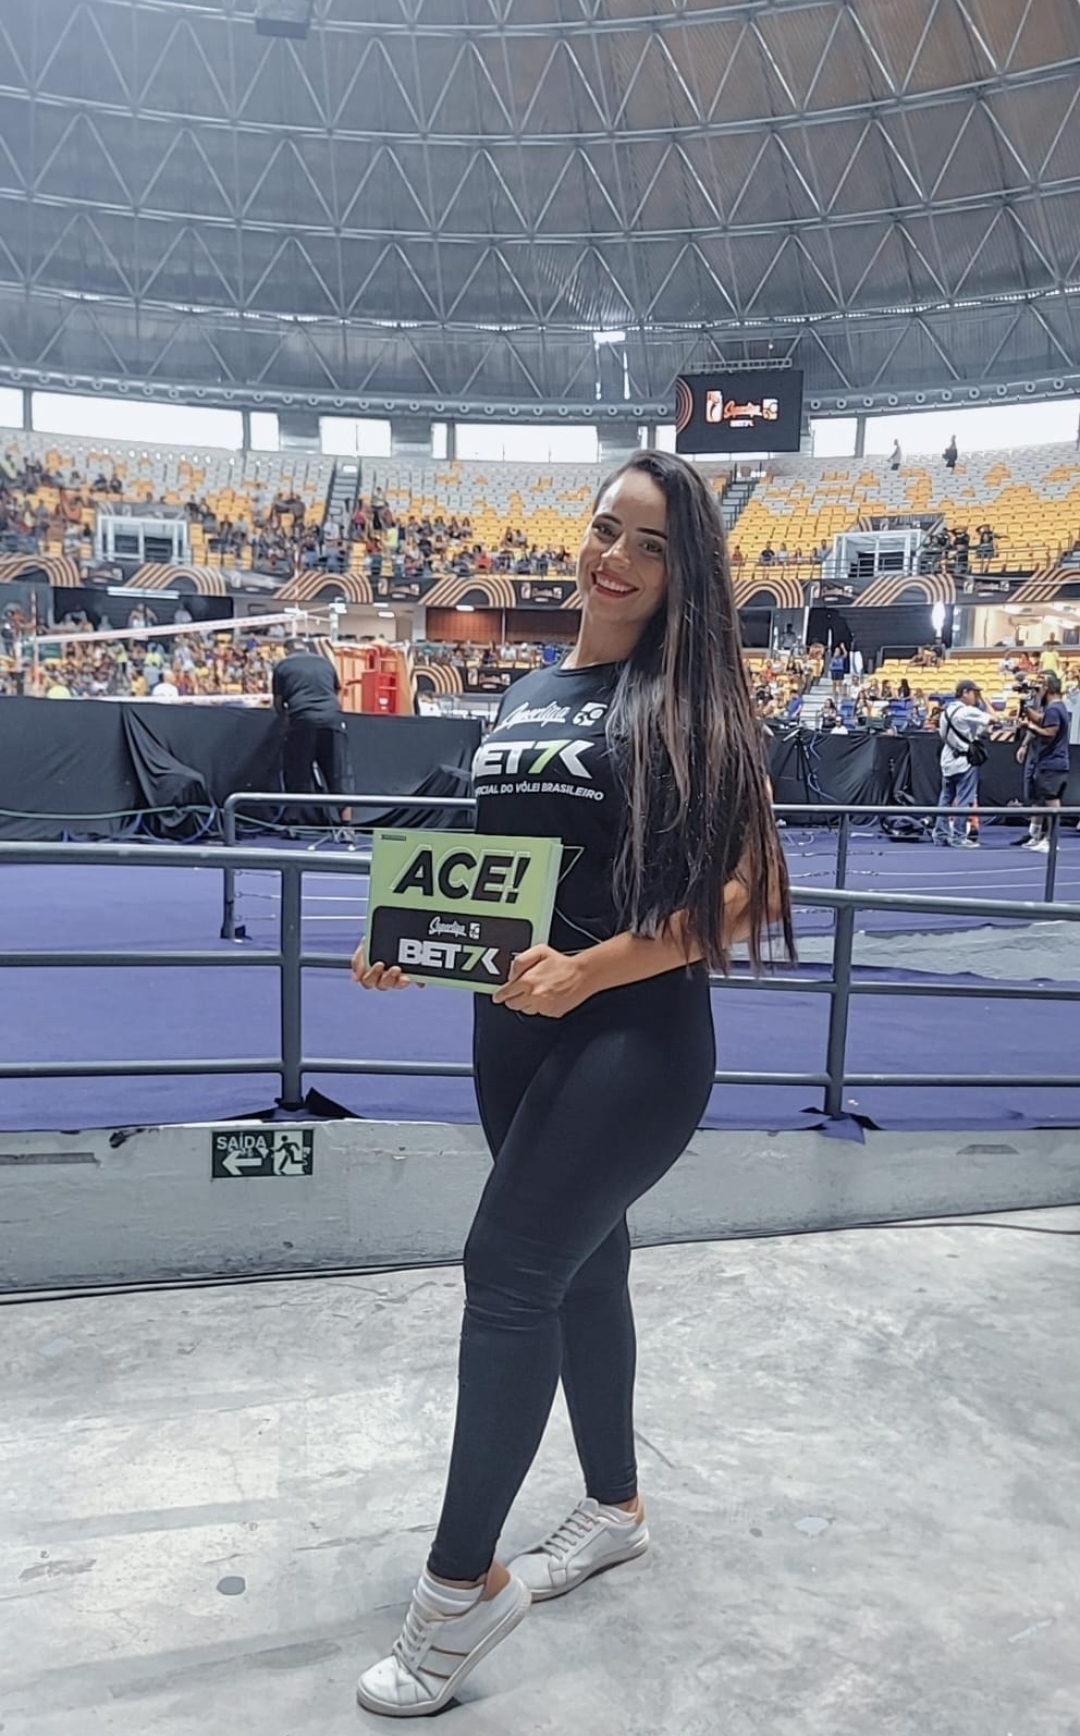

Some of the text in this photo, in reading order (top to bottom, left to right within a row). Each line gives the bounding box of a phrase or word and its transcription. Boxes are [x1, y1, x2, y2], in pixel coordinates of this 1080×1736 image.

[471, 739, 596, 781] ET7K
[500, 783, 514, 794] DO
[515, 780, 540, 792] VÓLEI
[541, 782, 604, 801] BRASILEIRO
[391, 845, 531, 904] ACE!
[398, 938, 500, 975] BET7K
[216, 1132, 267, 1151] SAÍDA
